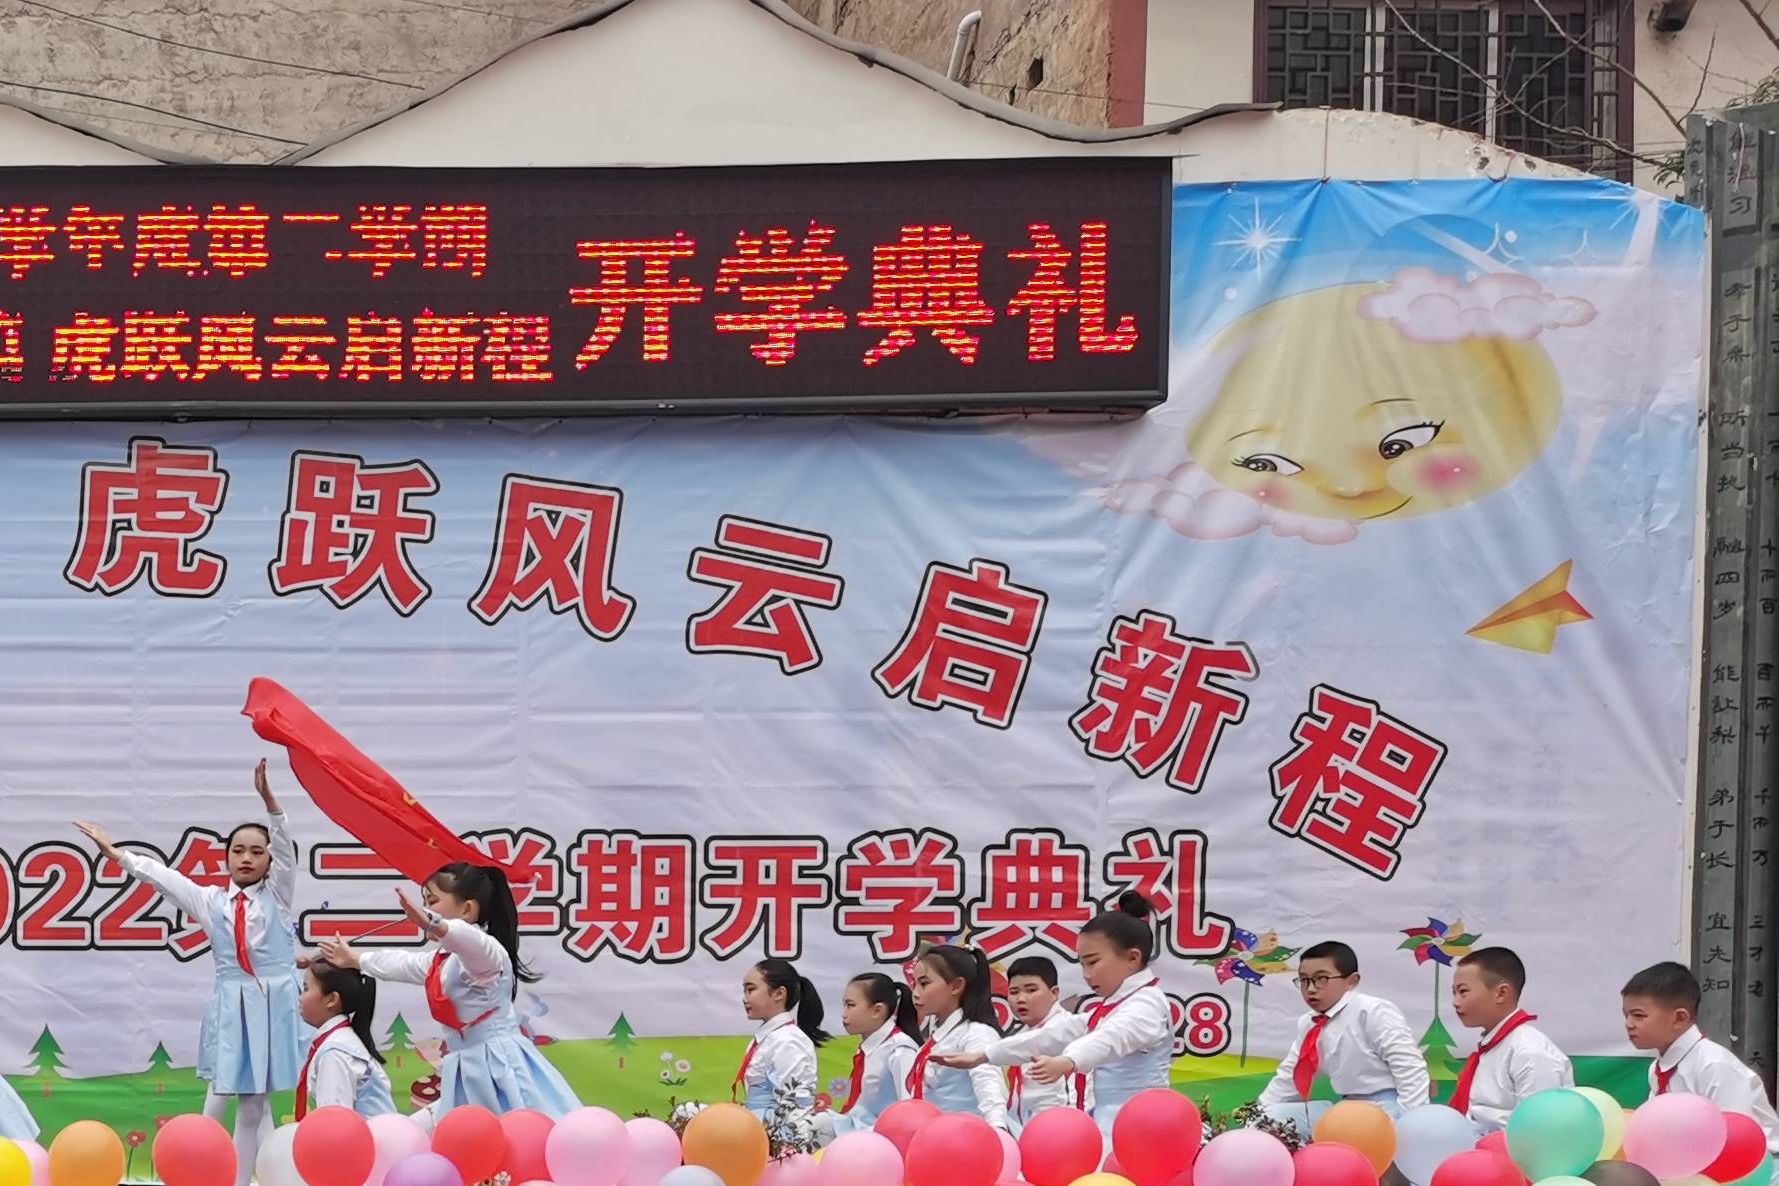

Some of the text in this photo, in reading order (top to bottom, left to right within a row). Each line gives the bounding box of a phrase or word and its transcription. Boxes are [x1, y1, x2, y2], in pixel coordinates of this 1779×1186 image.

[568, 220, 1139, 371] 开学典礼
[63, 435, 1448, 882] 虎跃风云启新程
[1702, 911, 1733, 993] 宜先知
